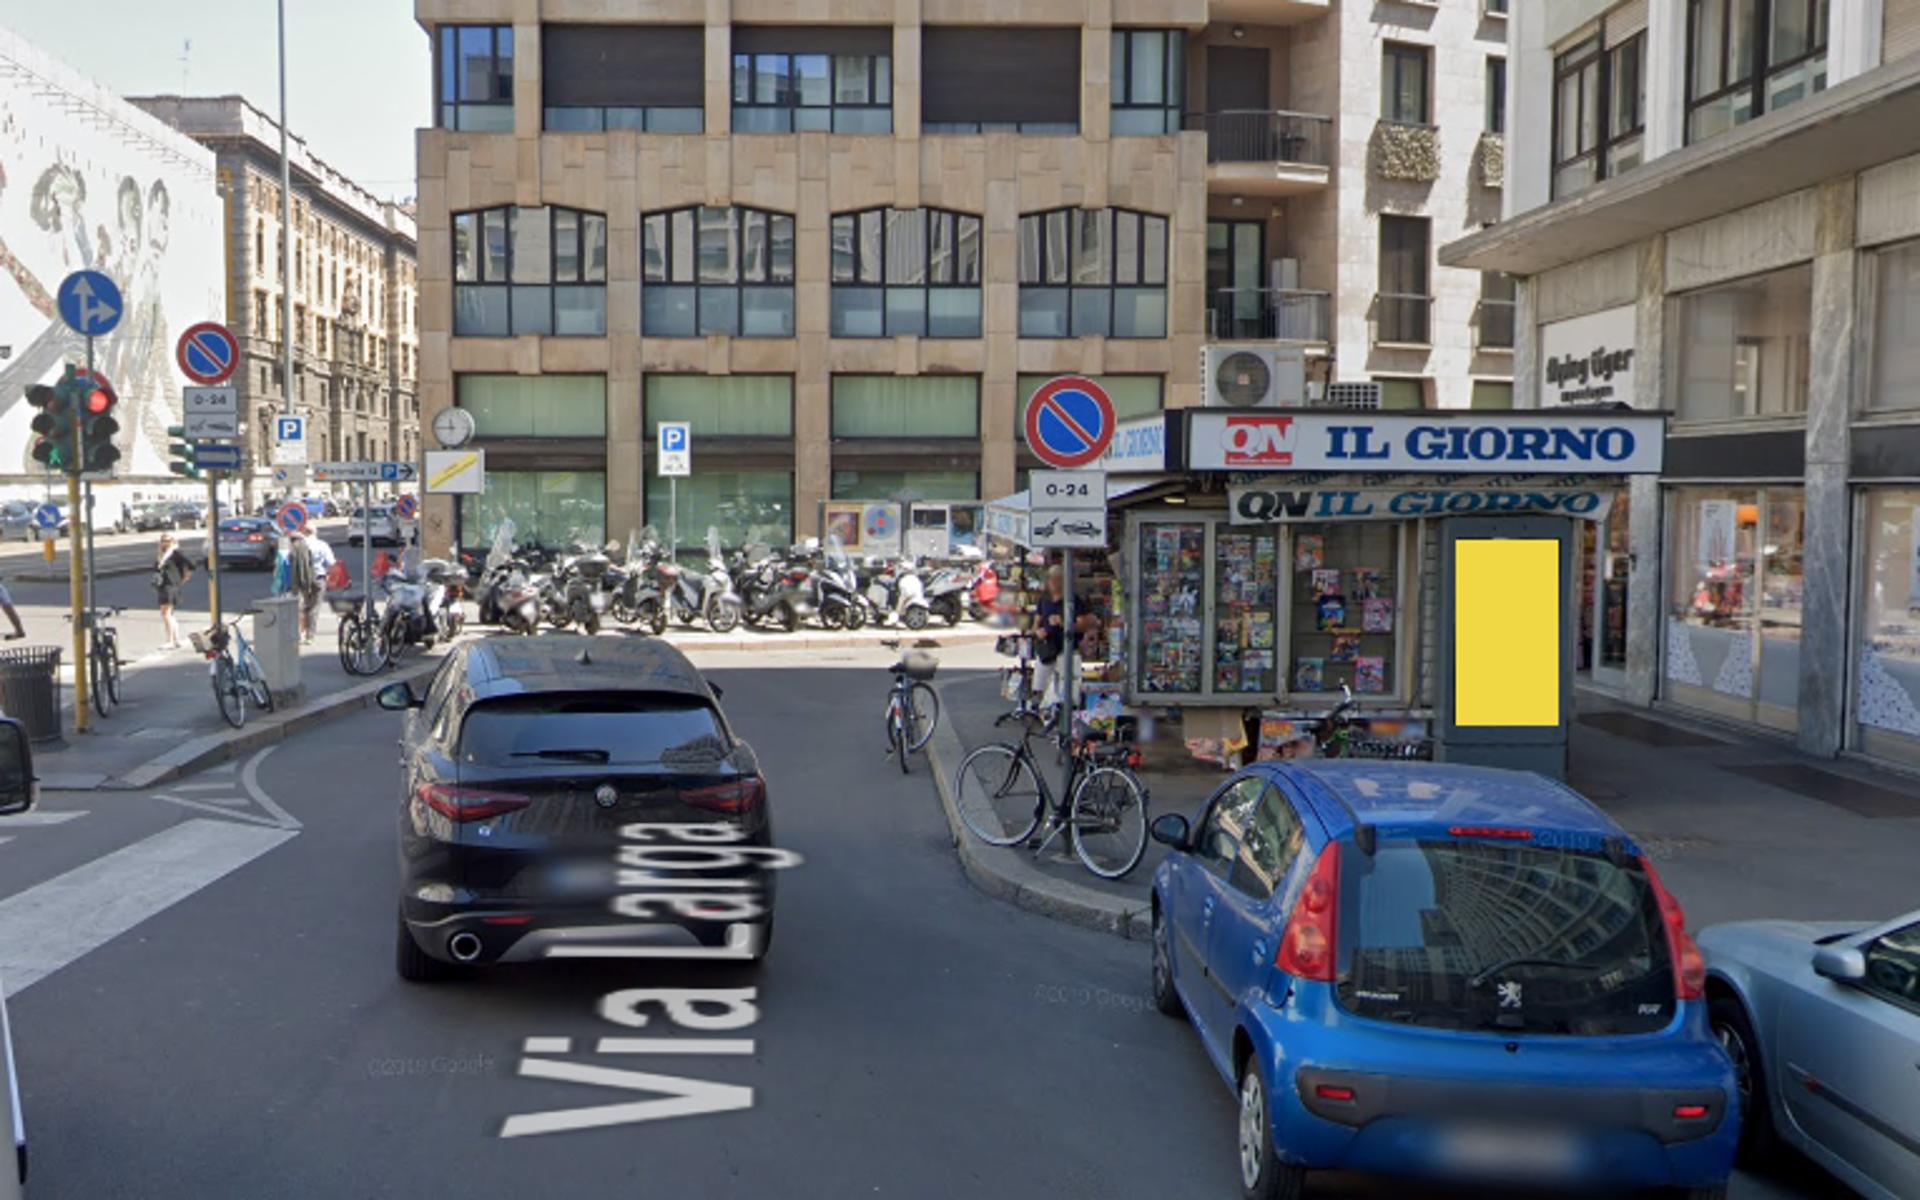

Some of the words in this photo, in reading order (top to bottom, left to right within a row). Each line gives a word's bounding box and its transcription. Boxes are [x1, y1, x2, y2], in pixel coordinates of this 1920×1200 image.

[1220, 423, 1297, 458] QN
[1325, 426, 1390, 459] IL
[1405, 425, 1635, 461] GIORNO
[1046, 484, 1089, 496] 0-24
[1237, 490, 1313, 521] QN
[1314, 490, 1374, 517] IL
[1388, 490, 1600, 516] GIORNO
